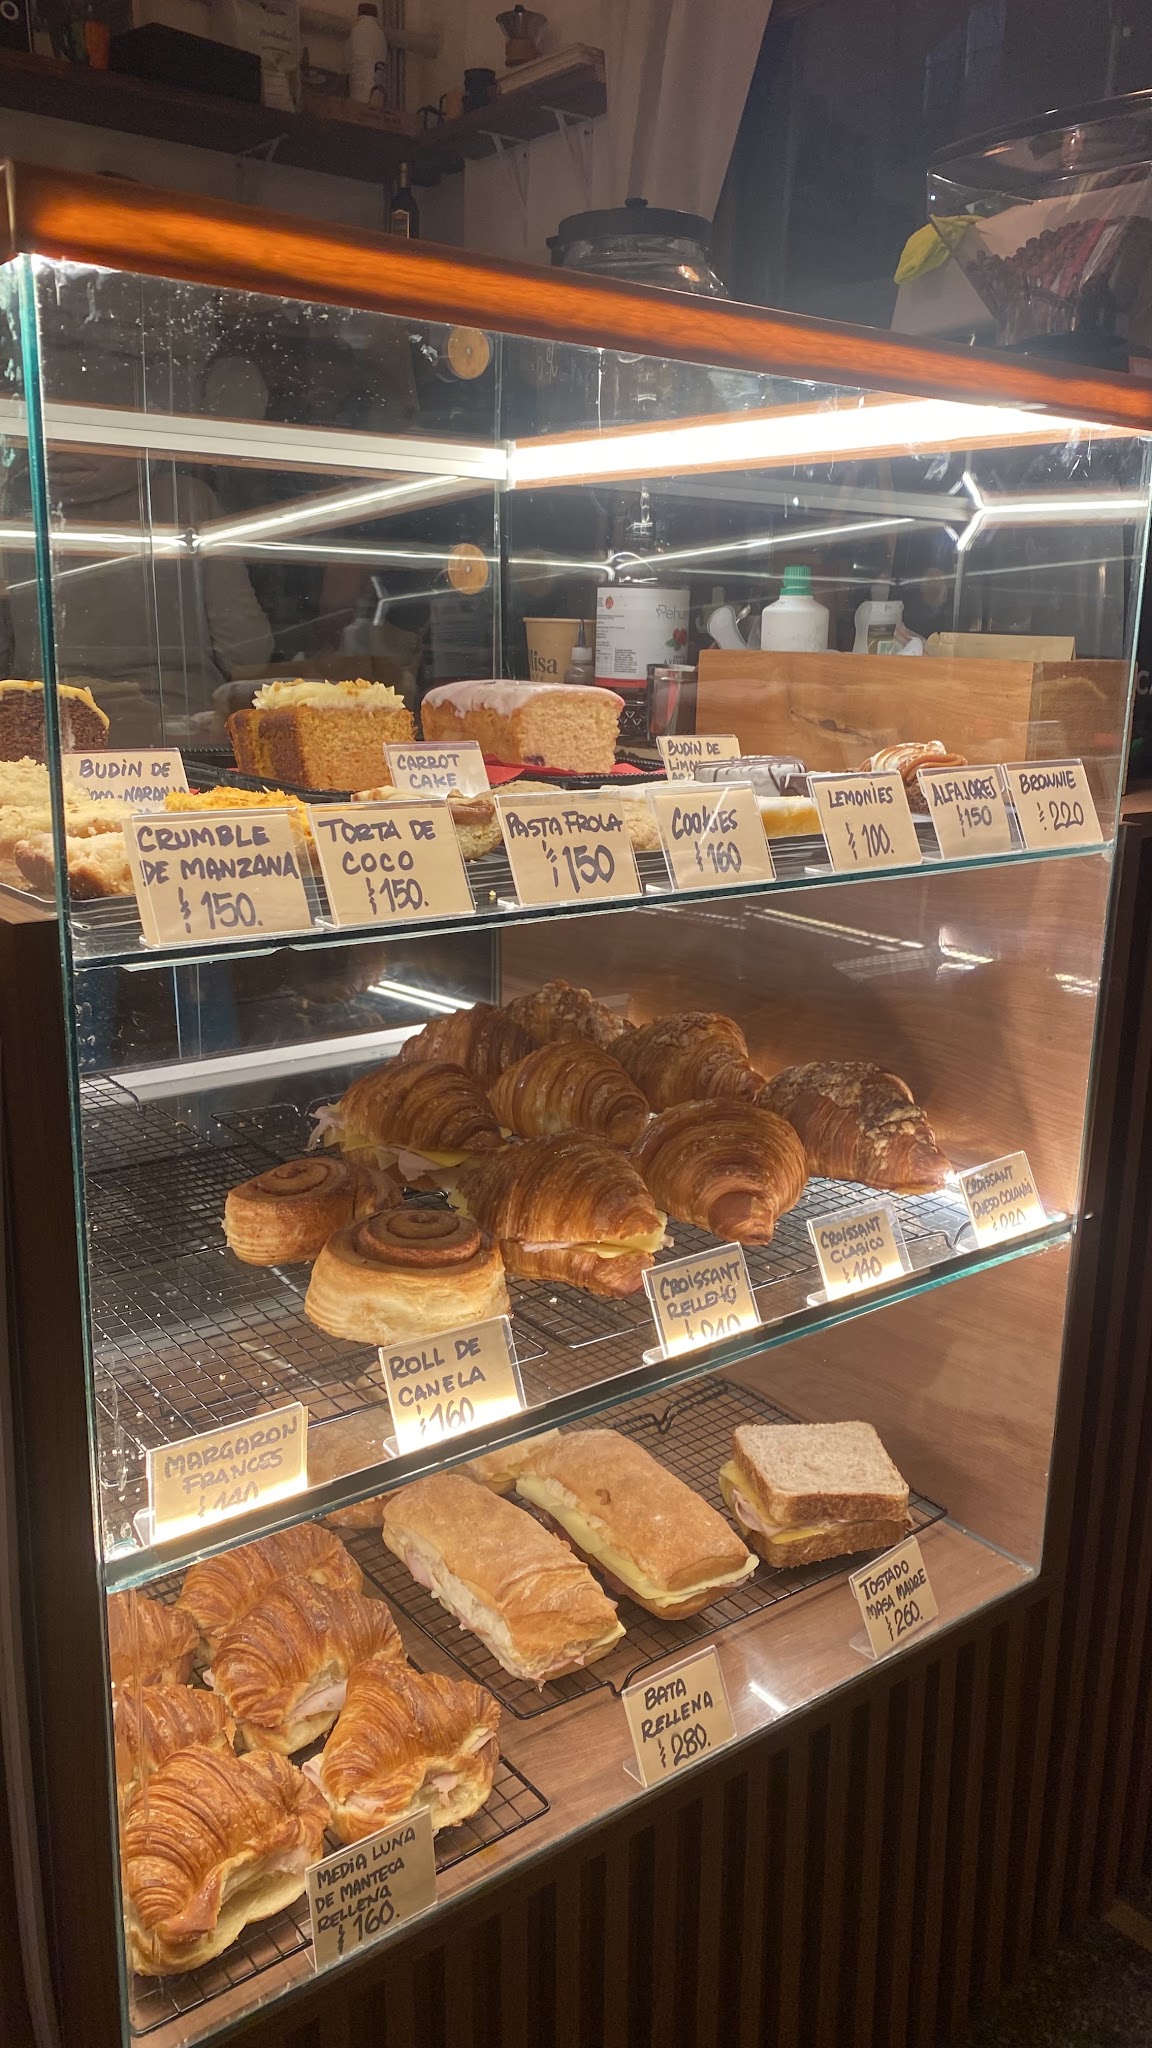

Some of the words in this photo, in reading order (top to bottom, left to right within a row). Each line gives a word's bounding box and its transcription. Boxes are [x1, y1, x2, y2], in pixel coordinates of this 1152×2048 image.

[396, 753, 460, 771] CARROT
[706, 742, 721, 755] DE
[151, 761, 171, 778] DE
[409, 773, 457, 789] CAKE
[930, 775, 997, 807] ALFAJORES
[136, 824, 271, 853] CRUMBLE
[318, 817, 402, 844] TORTA
[409, 819, 436, 841] DE
[505, 811, 563, 838] PASTA
[561, 810, 623, 835] FROLA
[671, 805, 739, 840] COOKIES
[140, 859, 170, 887] DE
[181, 851, 300, 882] MANZANA
[341, 850, 414, 875] COCO
[972, 1196, 1000, 1220] QUESO
[388, 1347, 446, 1381] ROLL
[454, 1337, 482, 1361] DE
[397, 1365, 487, 1408] CANELA
[182, 1448, 284, 1495] FRANCES
[858, 1560, 910, 1601] TOSTADO
[866, 1594, 896, 1620] MASA
[644, 1678, 687, 1711] BATA
[641, 1690, 713, 1743] RELLENA
[372, 1827, 416, 1861] LUNA
[314, 1891, 335, 1914] DE
[339, 1857, 406, 1903] MANTECA
